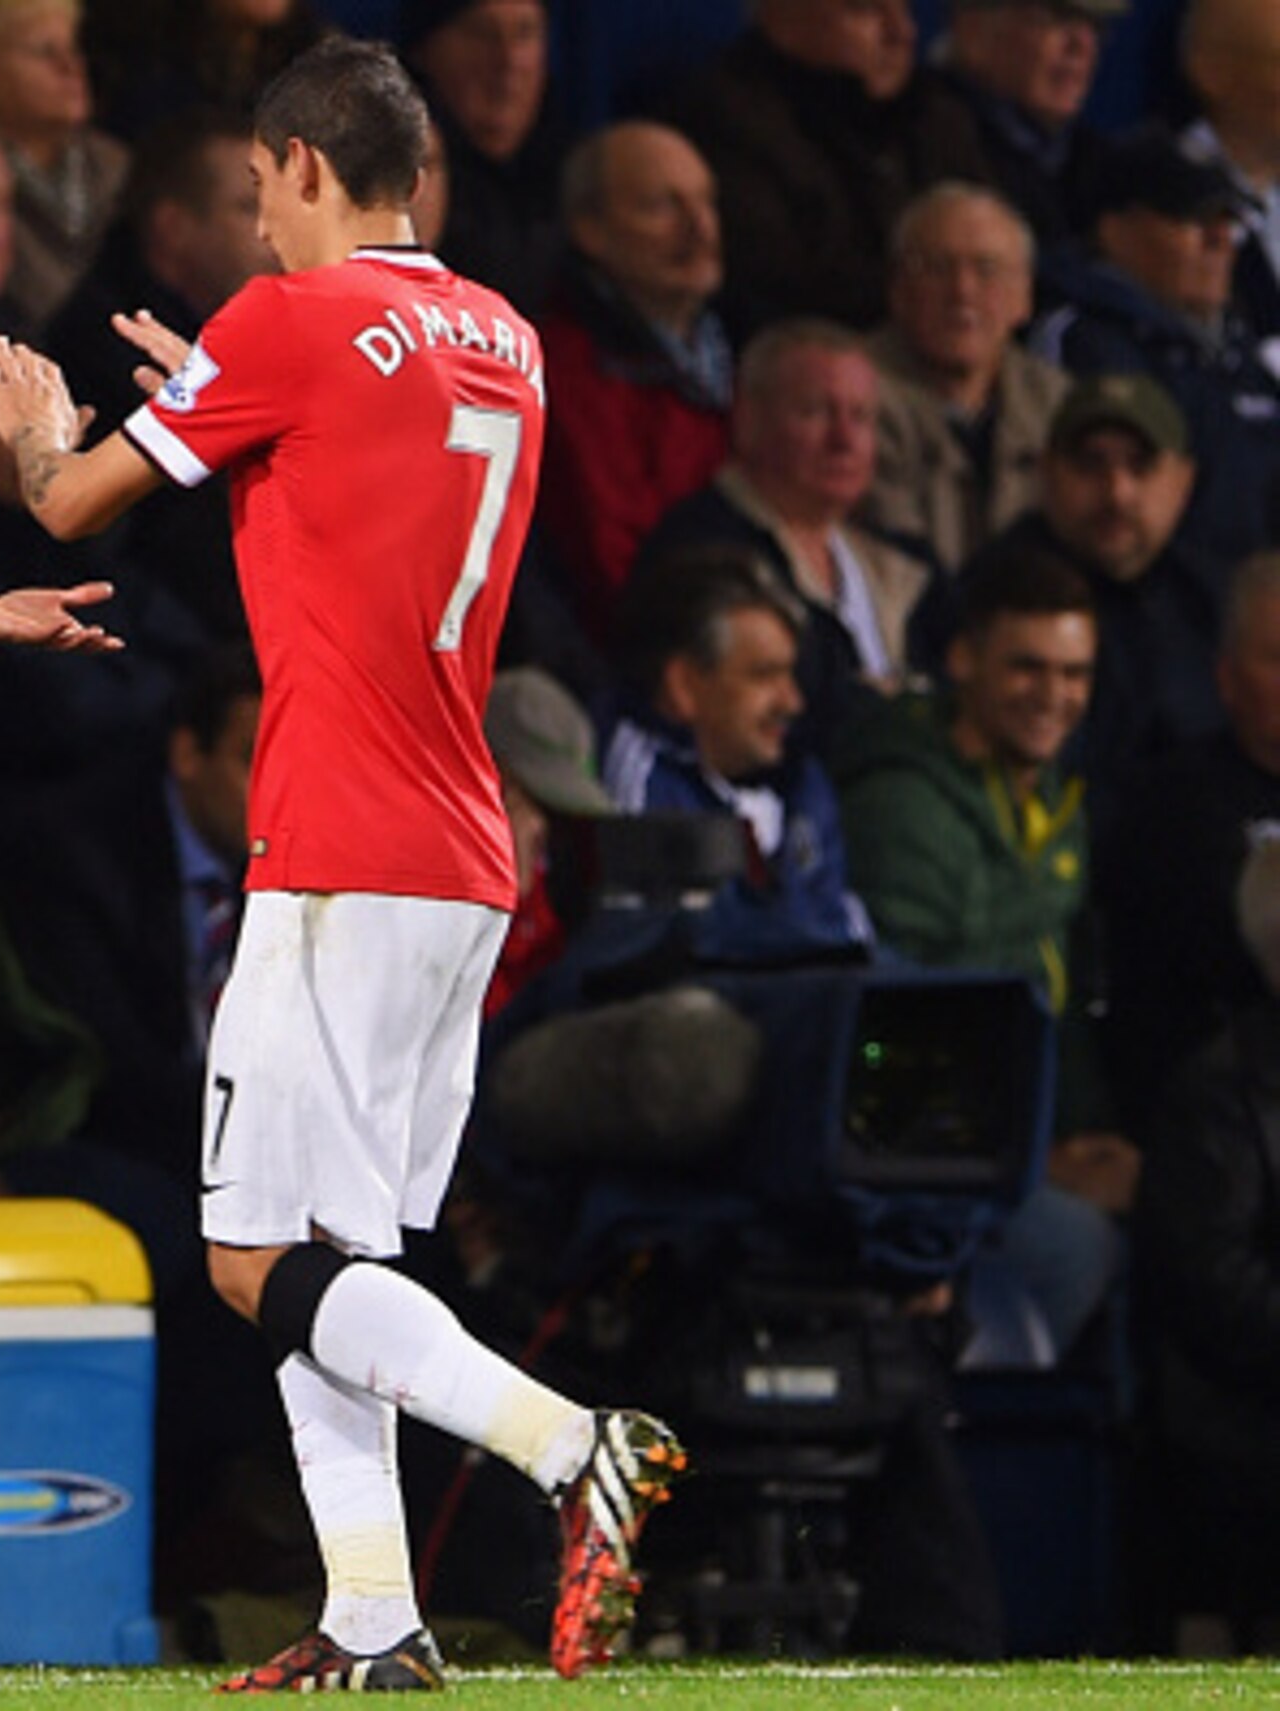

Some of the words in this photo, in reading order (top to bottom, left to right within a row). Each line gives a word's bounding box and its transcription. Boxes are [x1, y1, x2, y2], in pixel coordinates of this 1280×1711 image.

[353, 308, 418, 377] DI
[433, 404, 522, 652] 7
[213, 1070, 235, 1168] 7
